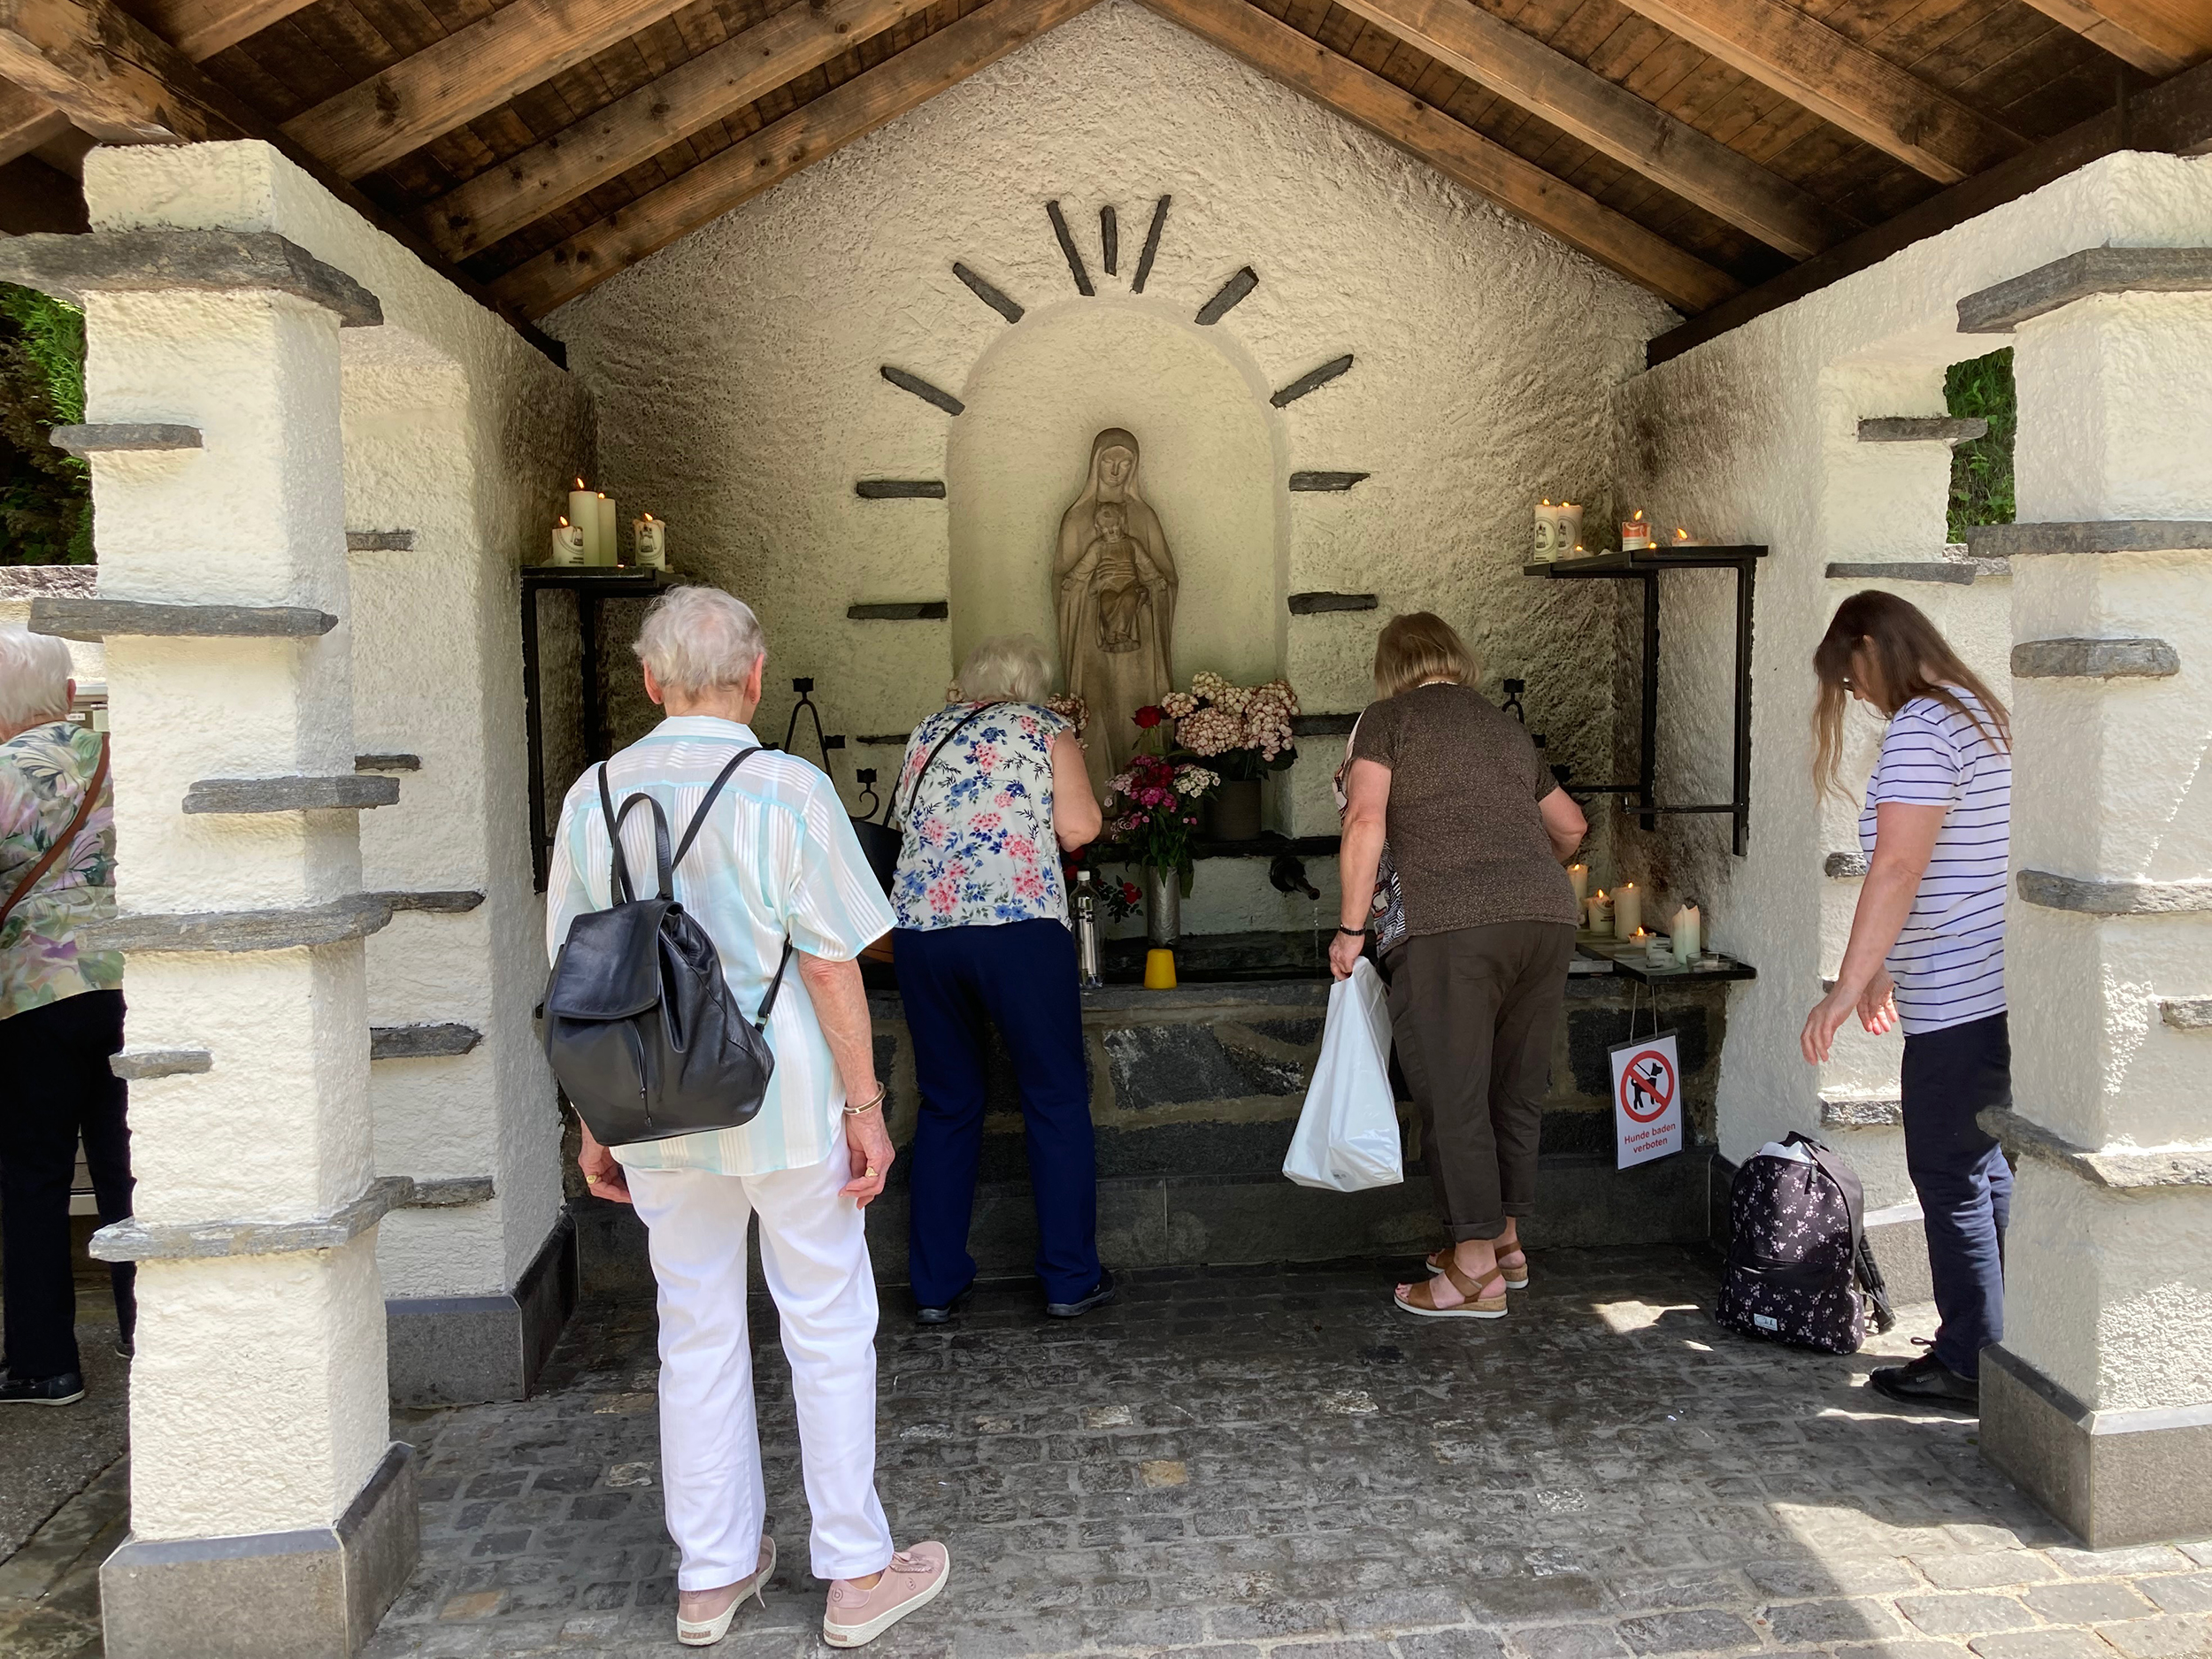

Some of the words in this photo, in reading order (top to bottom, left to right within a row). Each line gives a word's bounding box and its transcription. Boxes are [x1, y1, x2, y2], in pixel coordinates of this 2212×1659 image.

[1624, 1131, 1650, 1144] Hunde
[1652, 1123, 1676, 1136] baden
[1633, 1138, 1668, 1154] verboten
